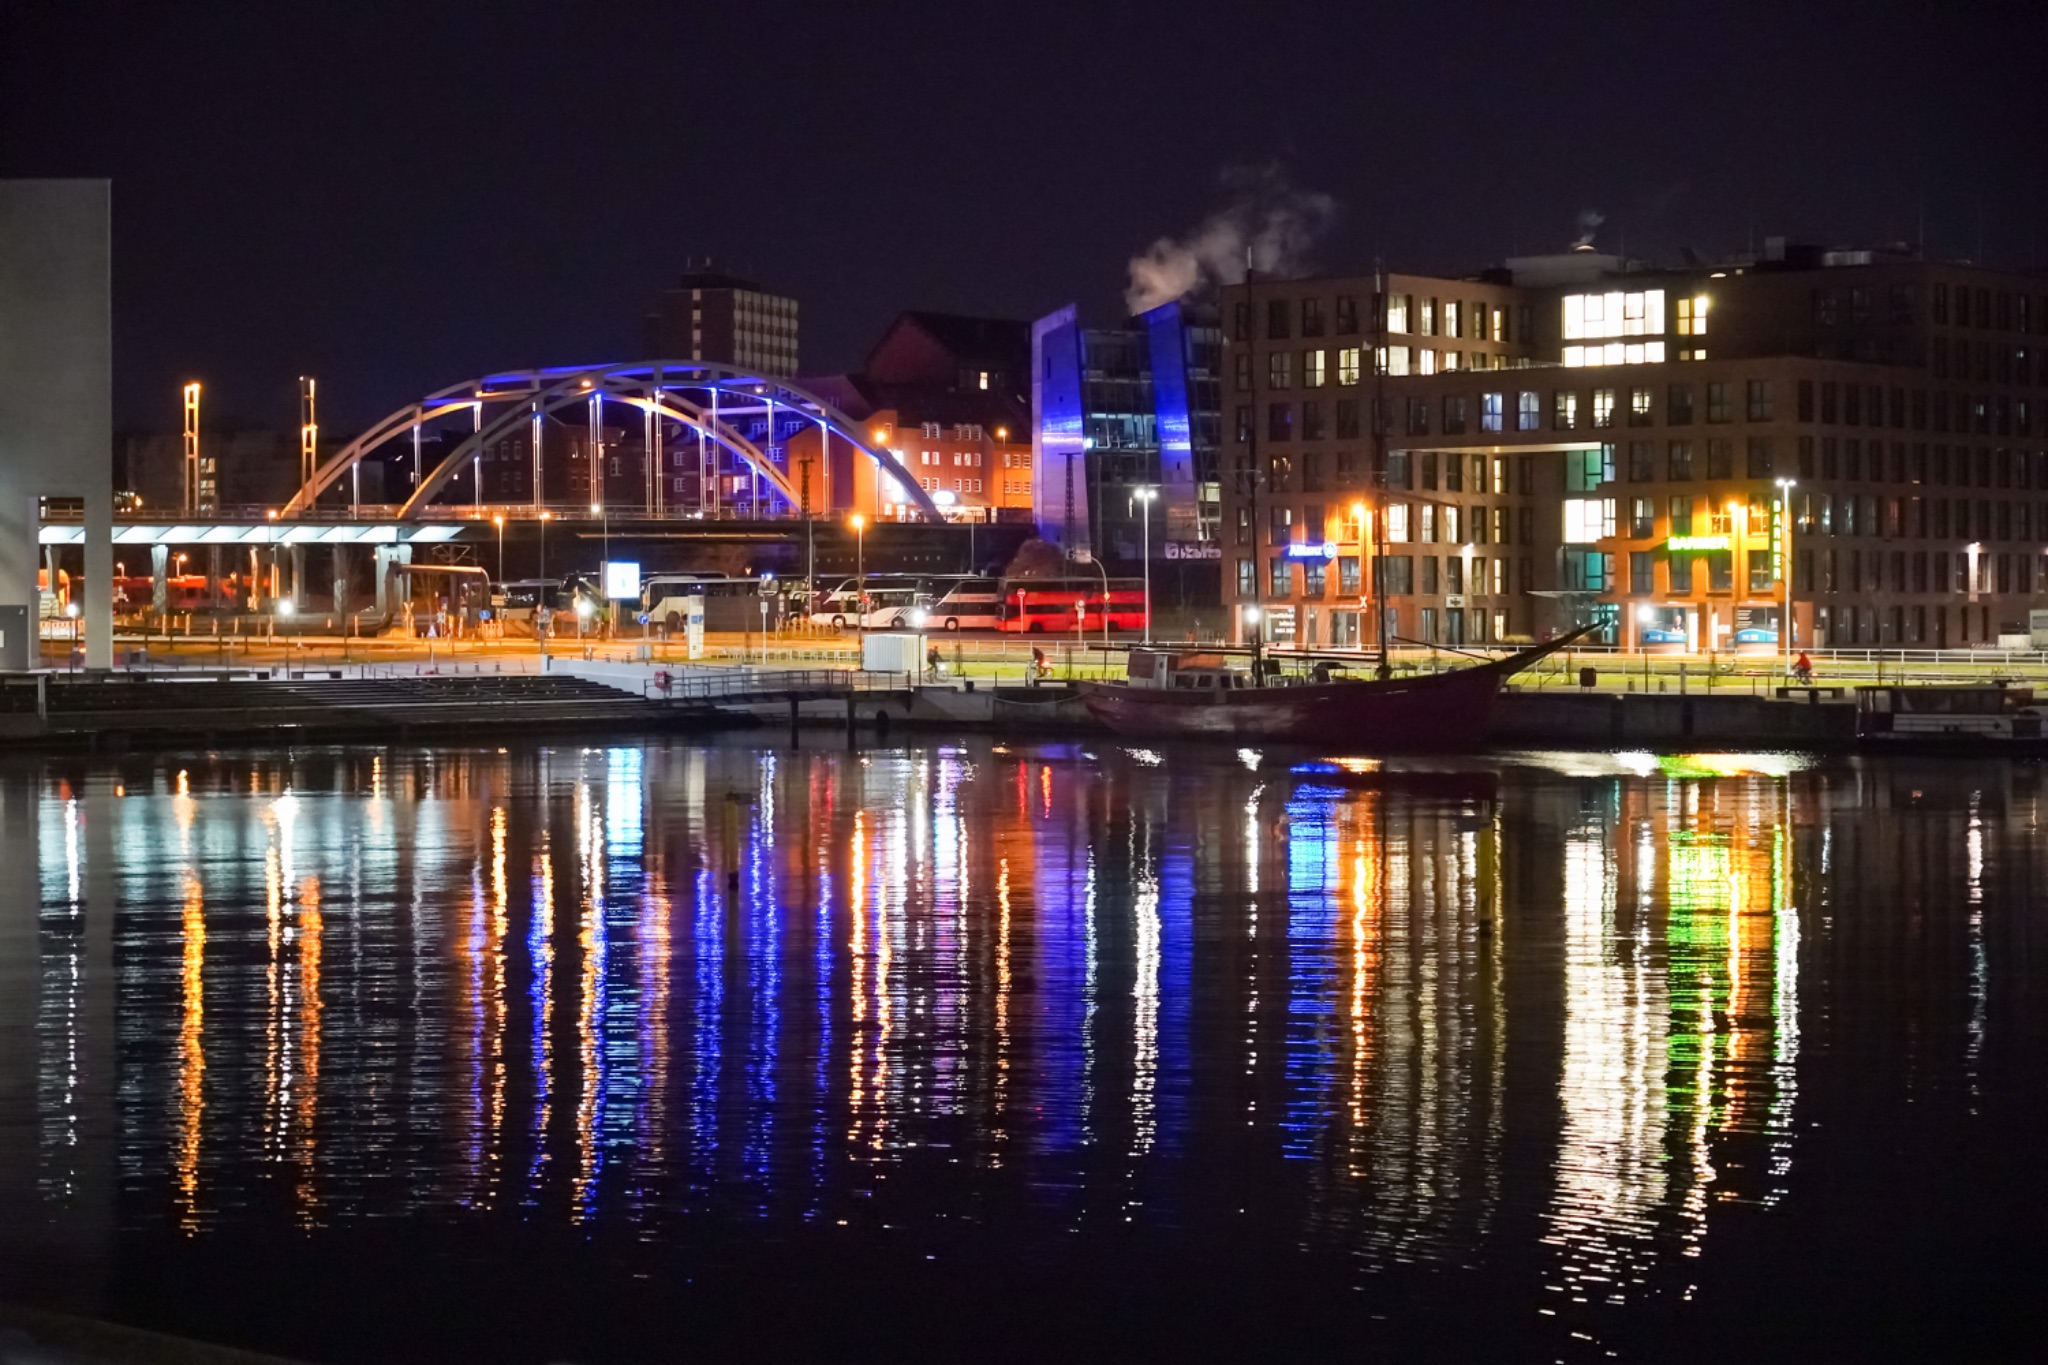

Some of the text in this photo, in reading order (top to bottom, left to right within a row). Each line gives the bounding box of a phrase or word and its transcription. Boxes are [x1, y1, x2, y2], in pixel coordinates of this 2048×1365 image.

[1668, 536, 1728, 550] BARMER
[1773, 500, 1781, 580] BARMER
[1289, 544, 1323, 556] Allianz
